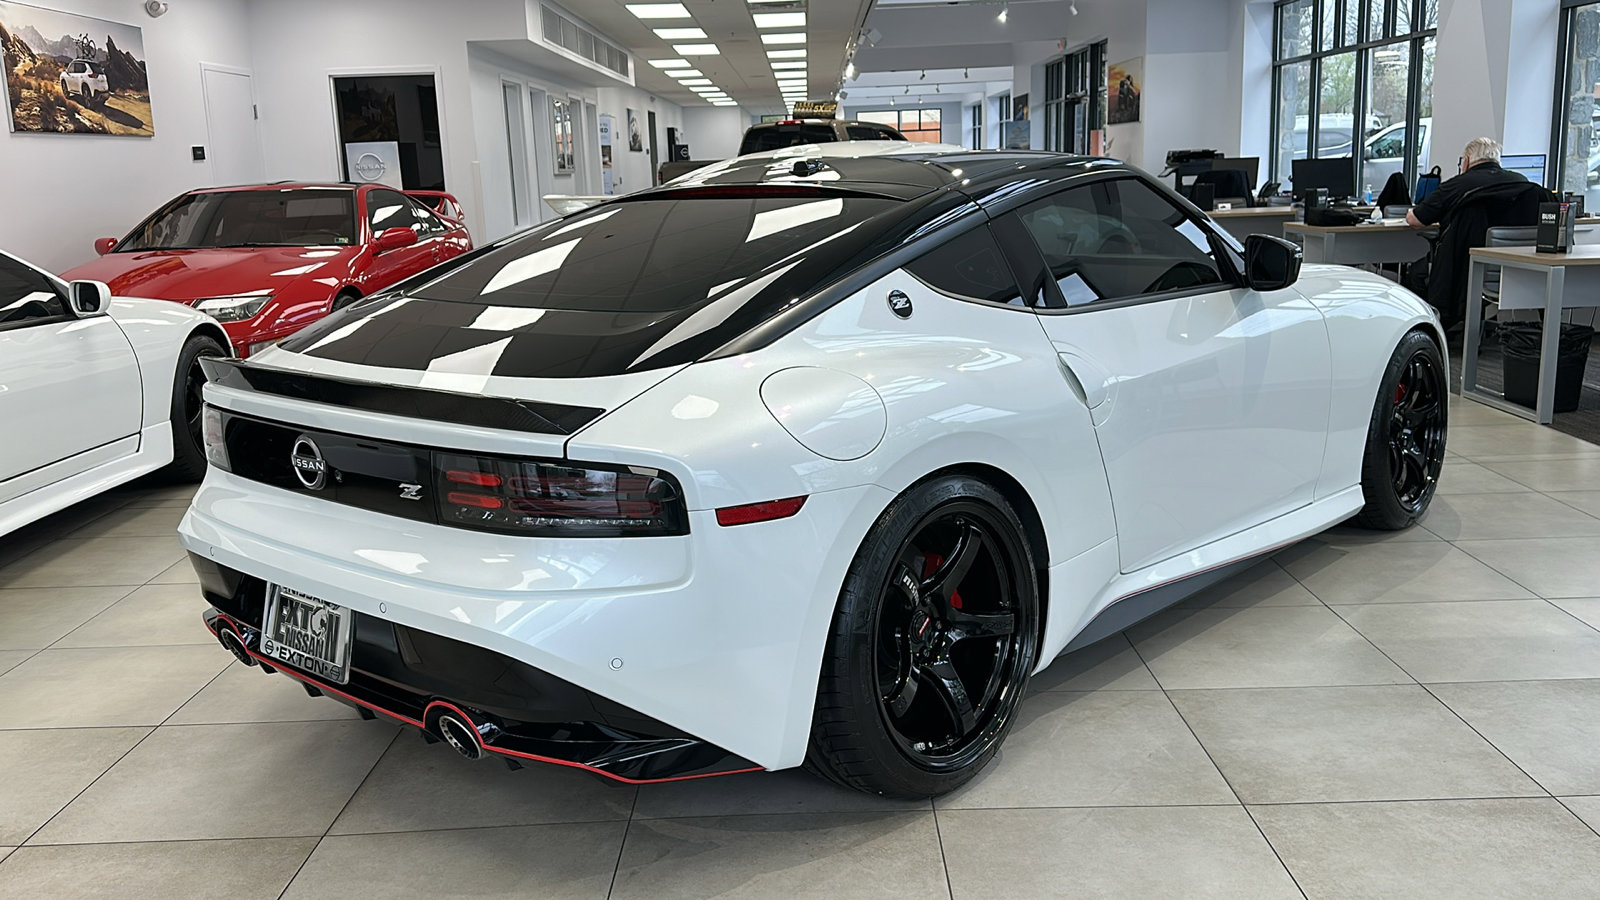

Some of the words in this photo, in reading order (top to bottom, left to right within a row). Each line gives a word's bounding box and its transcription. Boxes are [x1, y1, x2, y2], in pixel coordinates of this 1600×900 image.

[355, 162, 386, 170] NISSAN
[291, 456, 324, 470] ISSAN
[398, 482, 423, 500] Z
[274, 595, 341, 662] EXTON
[285, 628, 325, 659] NISSAN
[279, 646, 325, 675] EXTON
